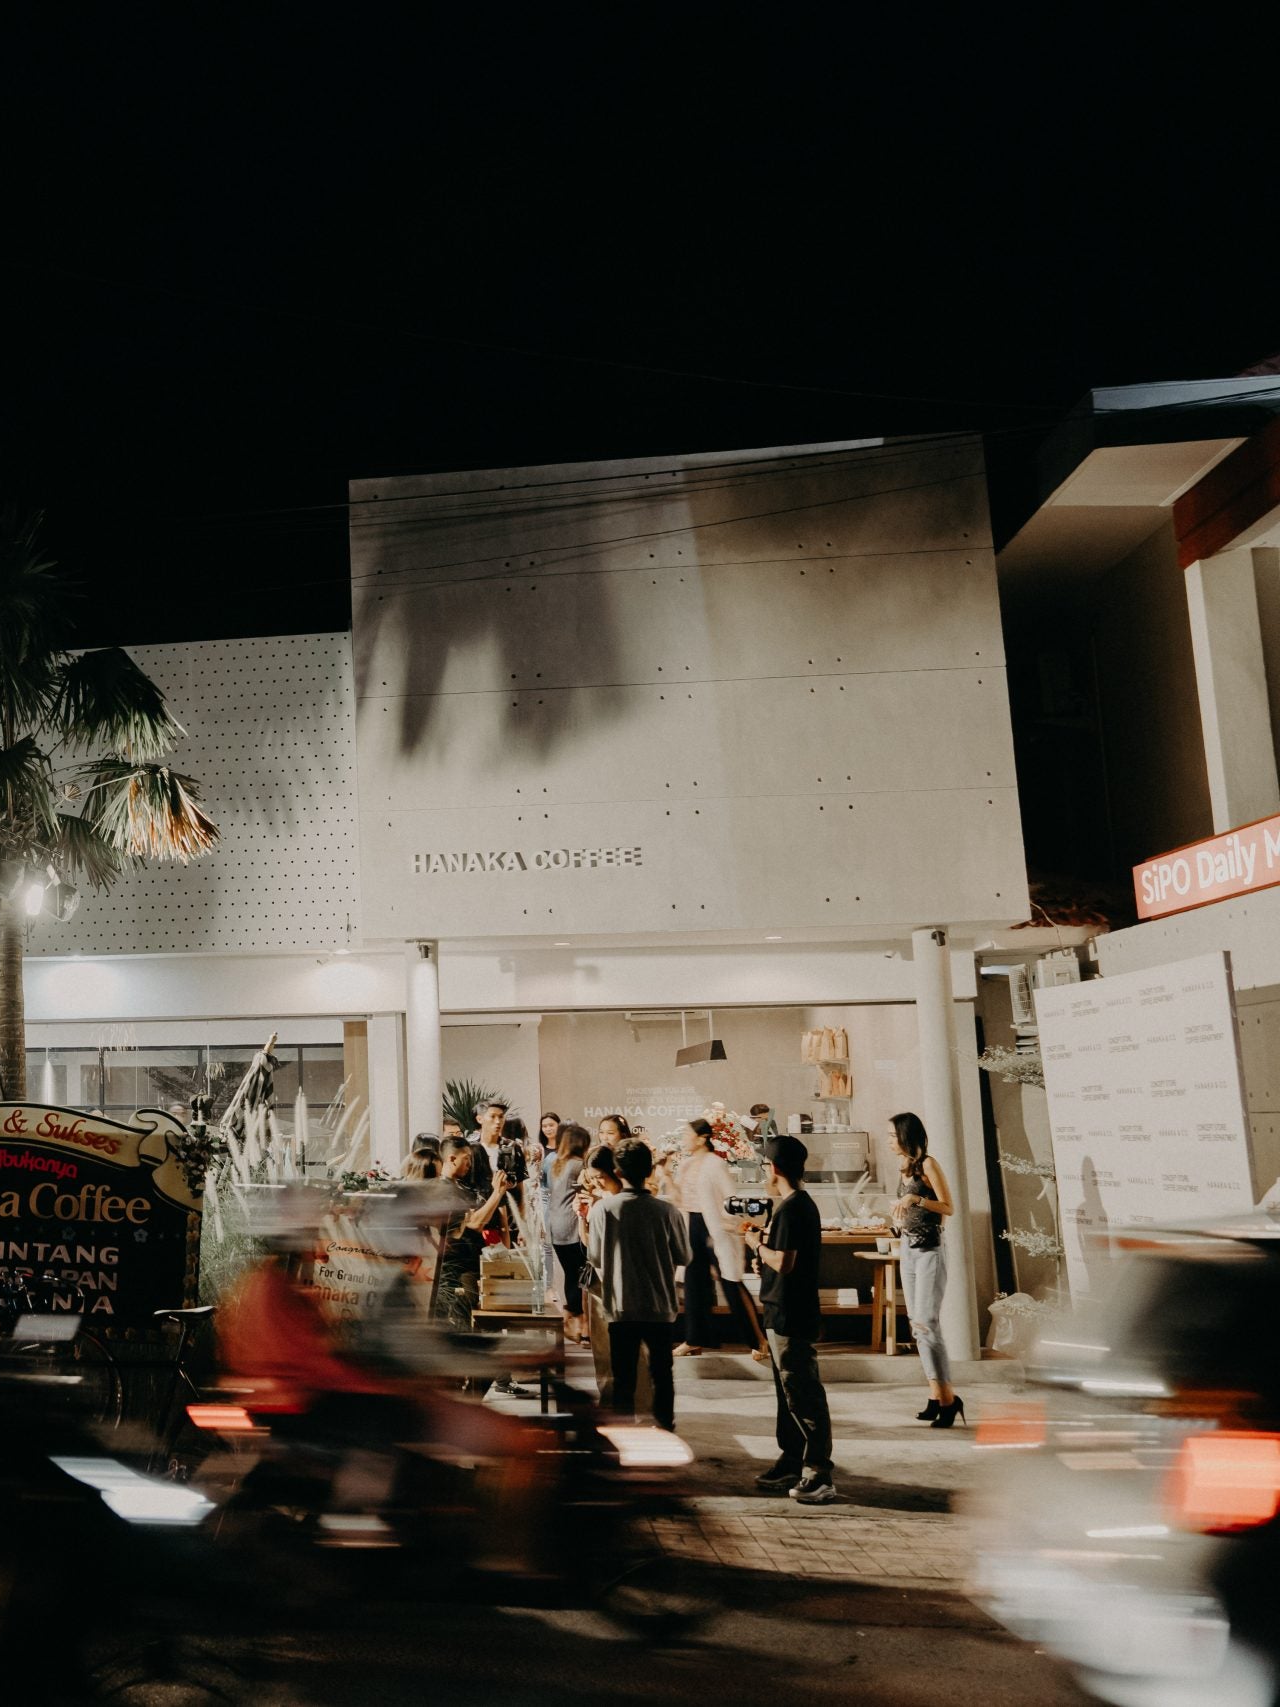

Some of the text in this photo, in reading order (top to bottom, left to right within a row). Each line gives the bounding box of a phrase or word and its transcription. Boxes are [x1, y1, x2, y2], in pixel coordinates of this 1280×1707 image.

[412, 847, 643, 873] HANAKA COFFEE
[1141, 863, 1191, 904] SiPO
[1196, 833, 1257, 885] Daily
[584, 1104, 704, 1117] HANAKA COFFEE
[4, 1109, 28, 1134] &
[36, 1112, 121, 1155] Sukses
[28, 1182, 152, 1225] Coffee
[319, 1265, 335, 1278] For
[336, 1269, 365, 1284] Grand
